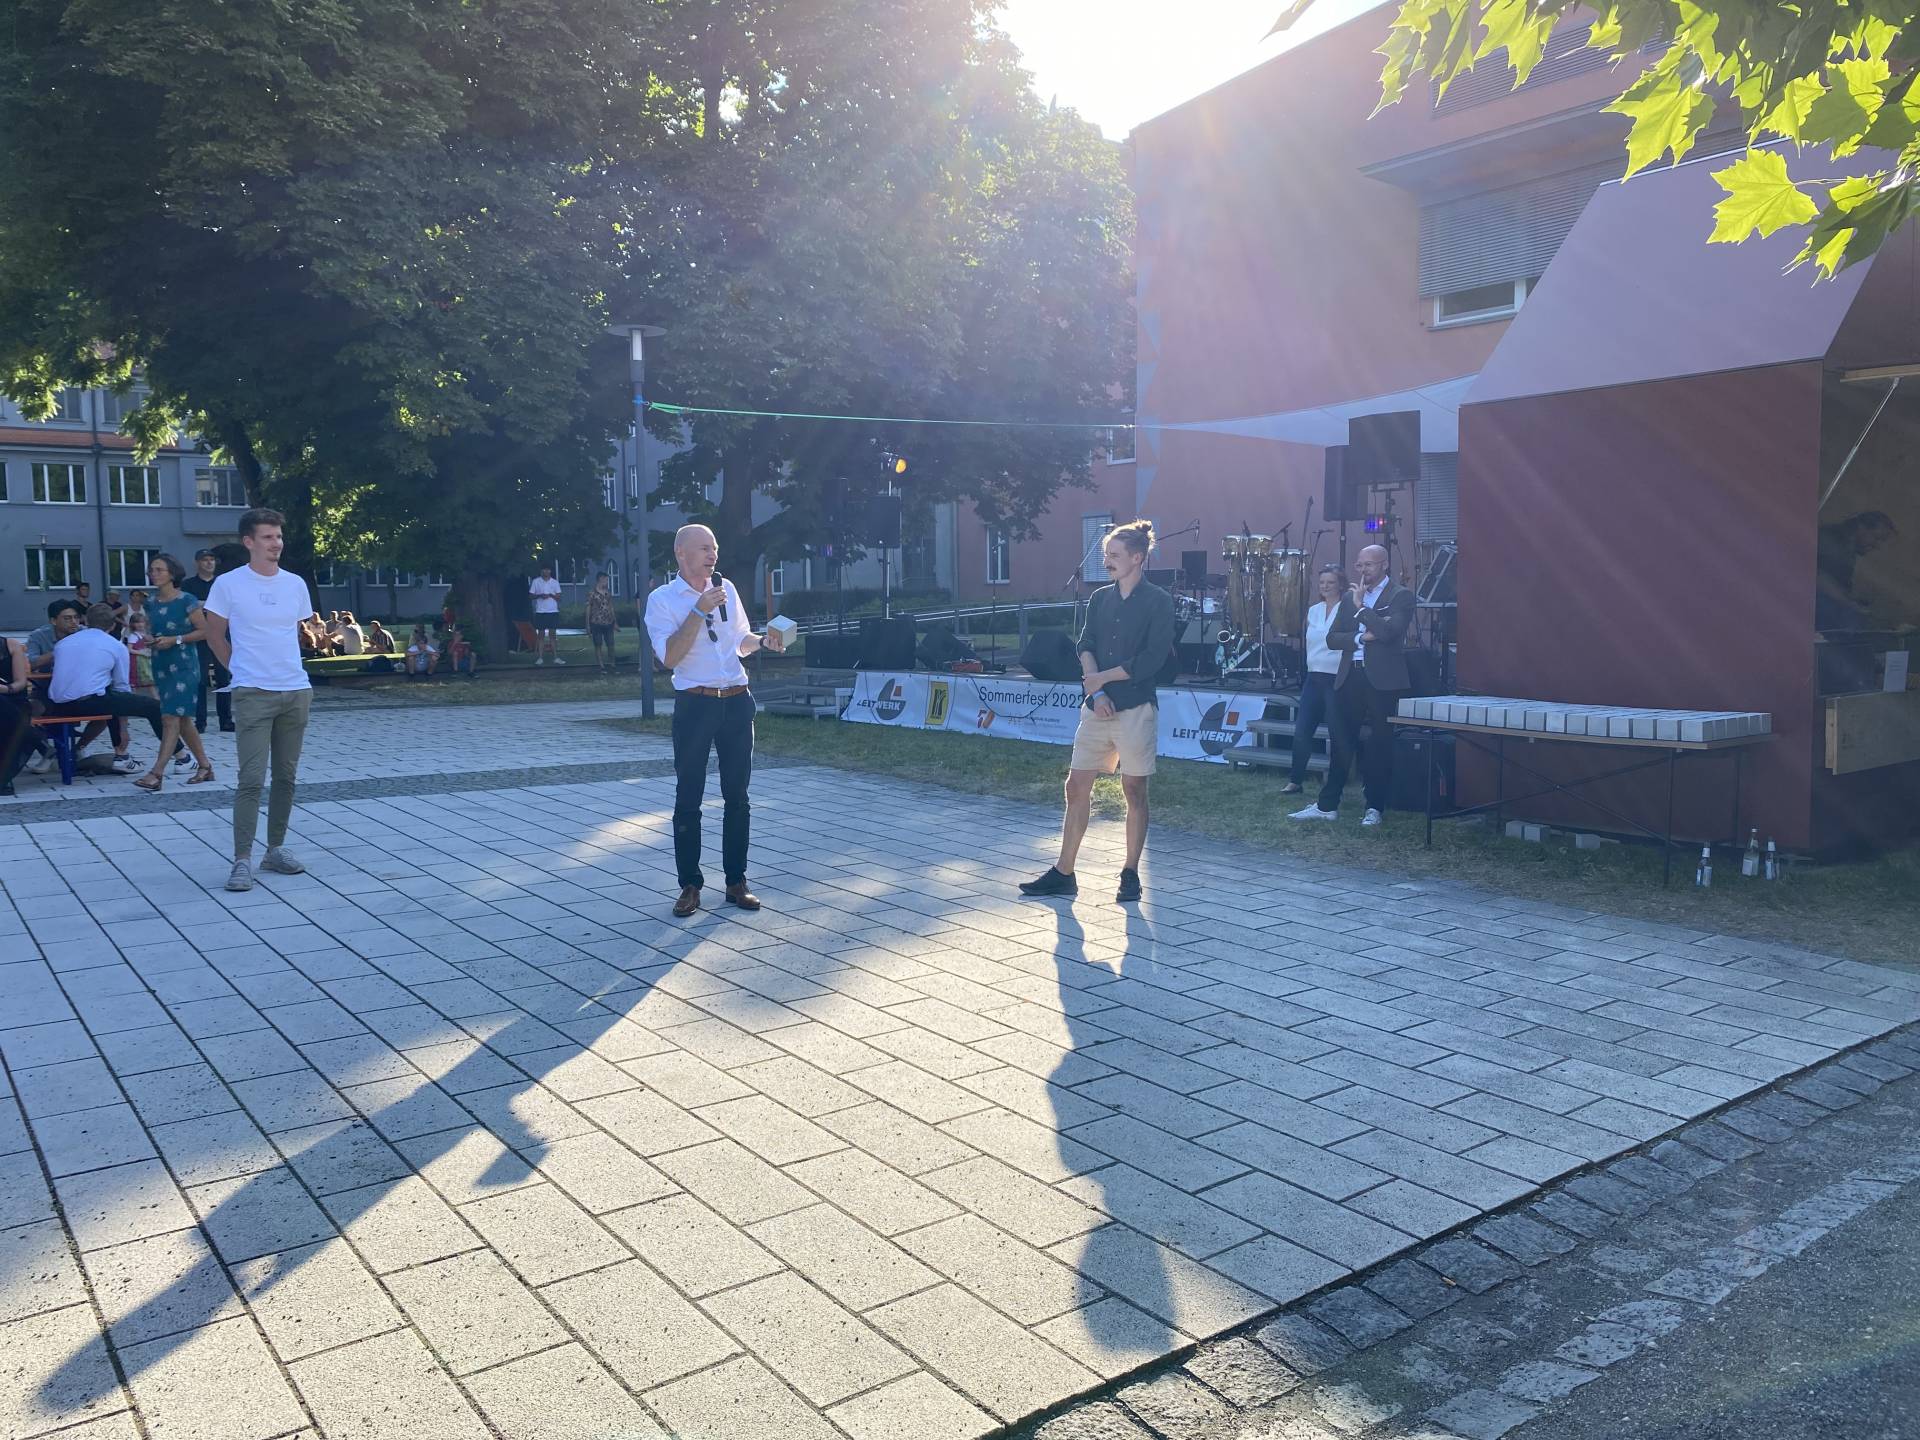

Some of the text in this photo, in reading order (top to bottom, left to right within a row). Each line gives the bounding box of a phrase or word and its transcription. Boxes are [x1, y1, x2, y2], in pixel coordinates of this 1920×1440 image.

[857, 699, 900, 711] LEITWERK
[980, 686, 1084, 709] Sommerfest 2022
[1172, 728, 1234, 743] LEITWERK
